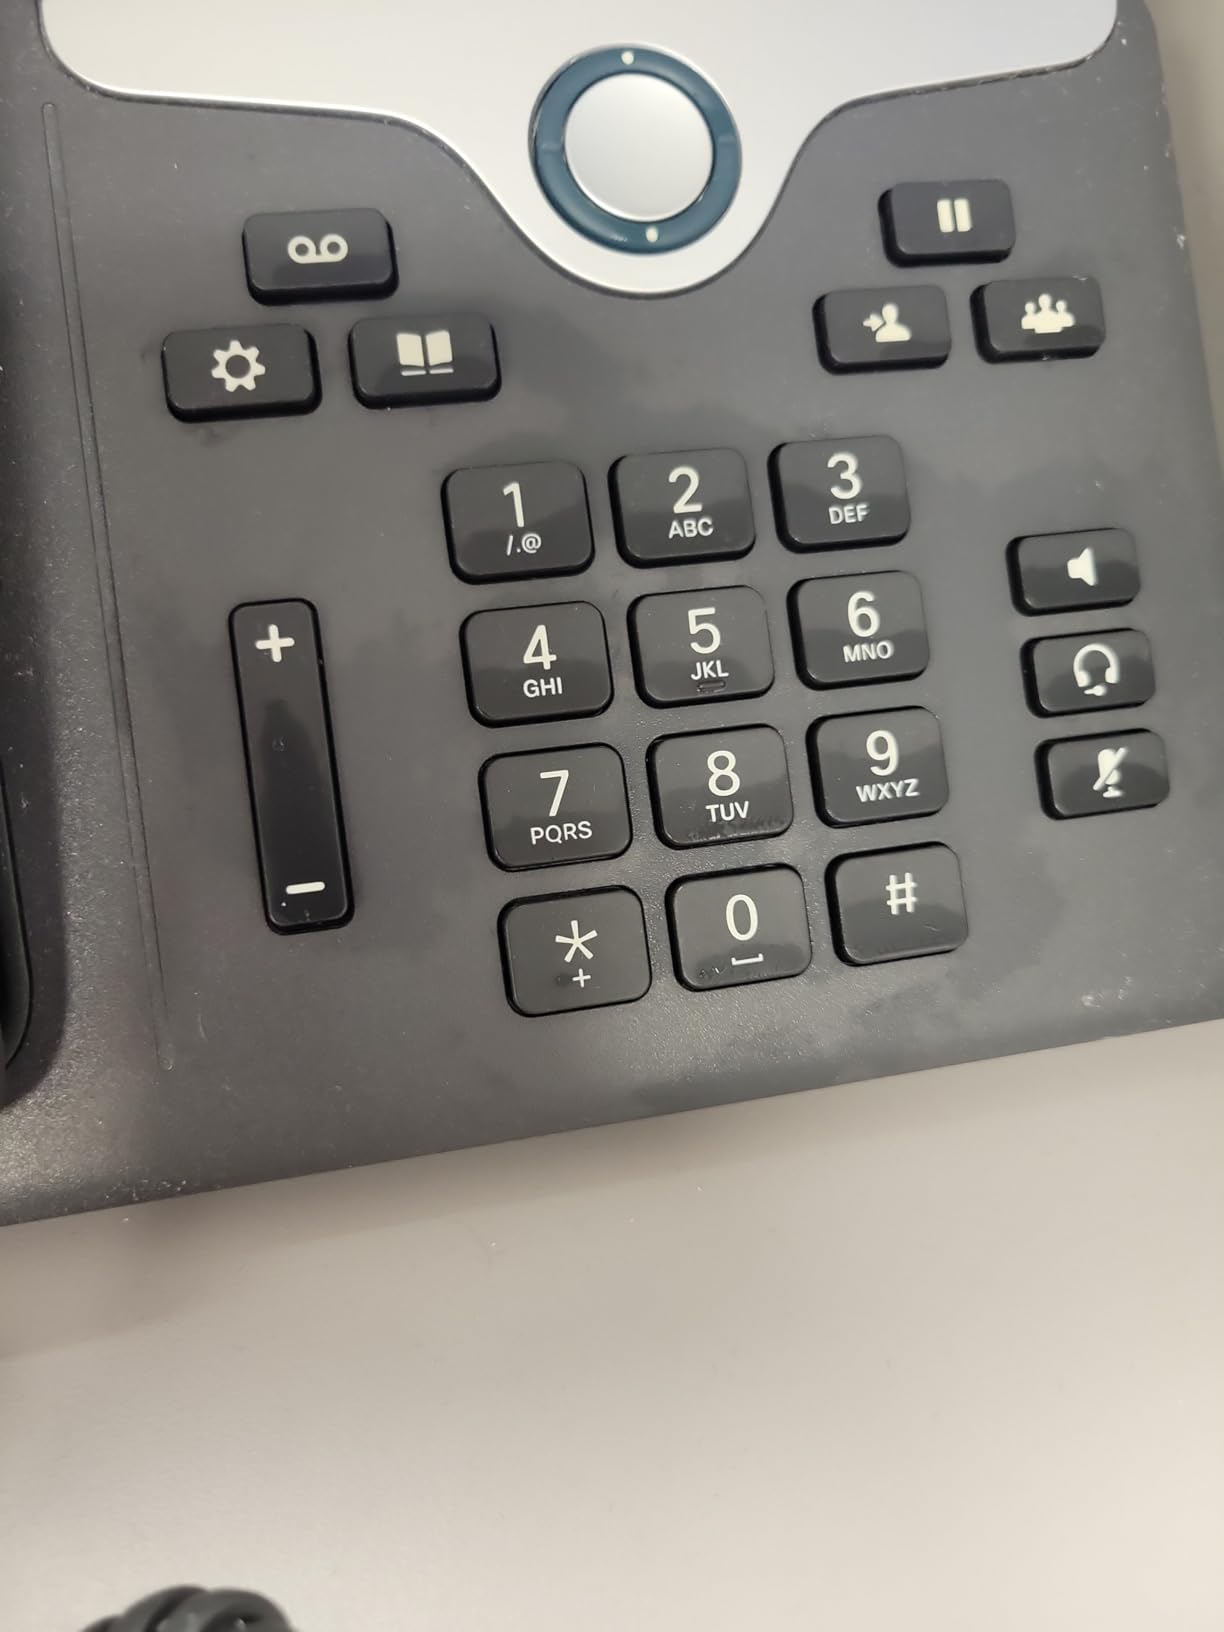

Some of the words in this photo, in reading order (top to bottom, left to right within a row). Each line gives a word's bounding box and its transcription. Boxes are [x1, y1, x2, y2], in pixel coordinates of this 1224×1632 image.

[668, 466, 703, 514] 2
[827, 452, 862, 500] 3
[502, 481, 525, 528] 1
[828, 503, 868, 525] DEF
[506, 532, 542, 556] /.@
[668, 516, 714, 539] ABC
[687, 606, 721, 654] 5
[847, 590, 880, 638] 6
[522, 624, 557, 670] 4
[842, 640, 894, 663] MNO
[522, 676, 563, 698] GHI
[690, 659, 730, 681] JKL
[707, 750, 741, 797] 8
[866, 729, 899, 776] 9
[539, 769, 570, 817] 7
[705, 800, 750, 823] TUV
[855, 778, 920, 803] WXYZ
[530, 820, 593, 845] PQRS
[885, 872, 918, 915] #
[725, 894, 759, 941] 0
